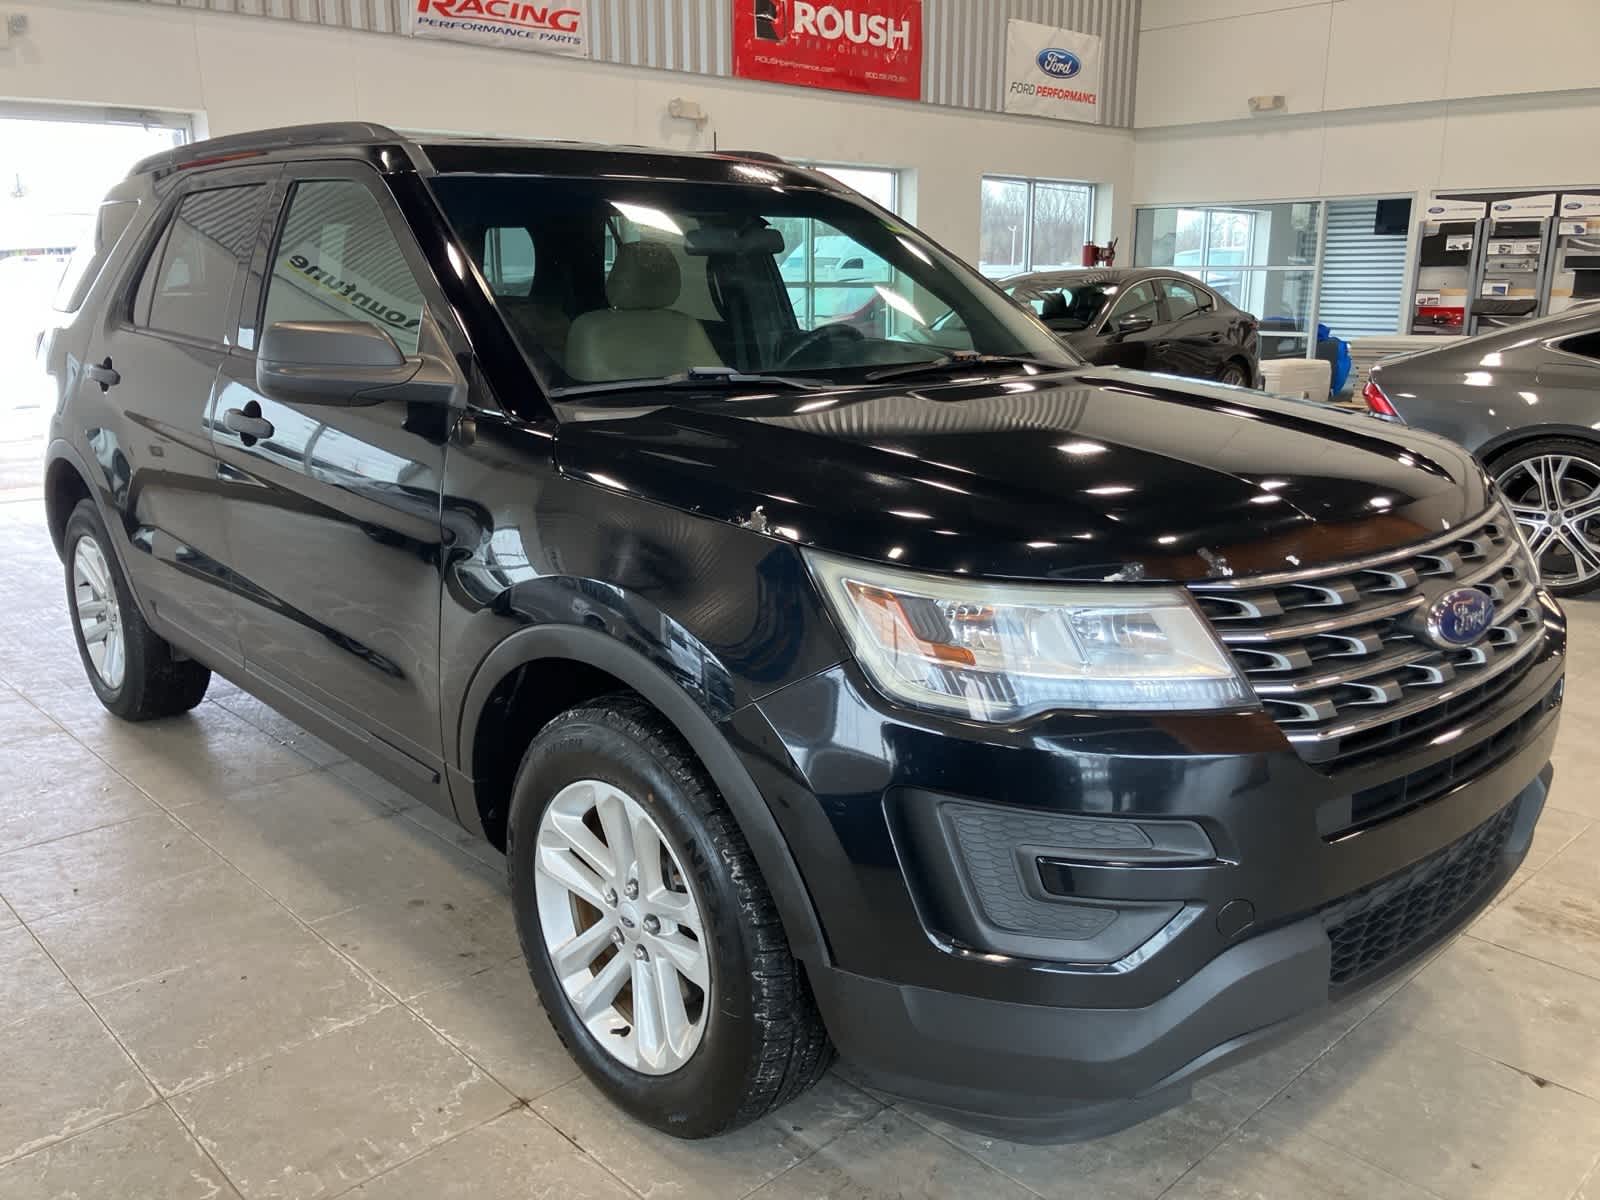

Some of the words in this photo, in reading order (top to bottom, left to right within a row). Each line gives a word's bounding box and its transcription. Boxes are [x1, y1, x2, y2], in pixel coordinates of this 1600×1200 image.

[417, 0, 580, 32] RACING
[418, 16, 535, 40] PERFORMANCE
[539, 32, 581, 45] PARTS
[794, 1, 910, 50] ROUSH
[1045, 52, 1072, 74] Ford
[1010, 82, 1036, 96] FORD
[1036, 86, 1096, 105] PERFORMANCE
